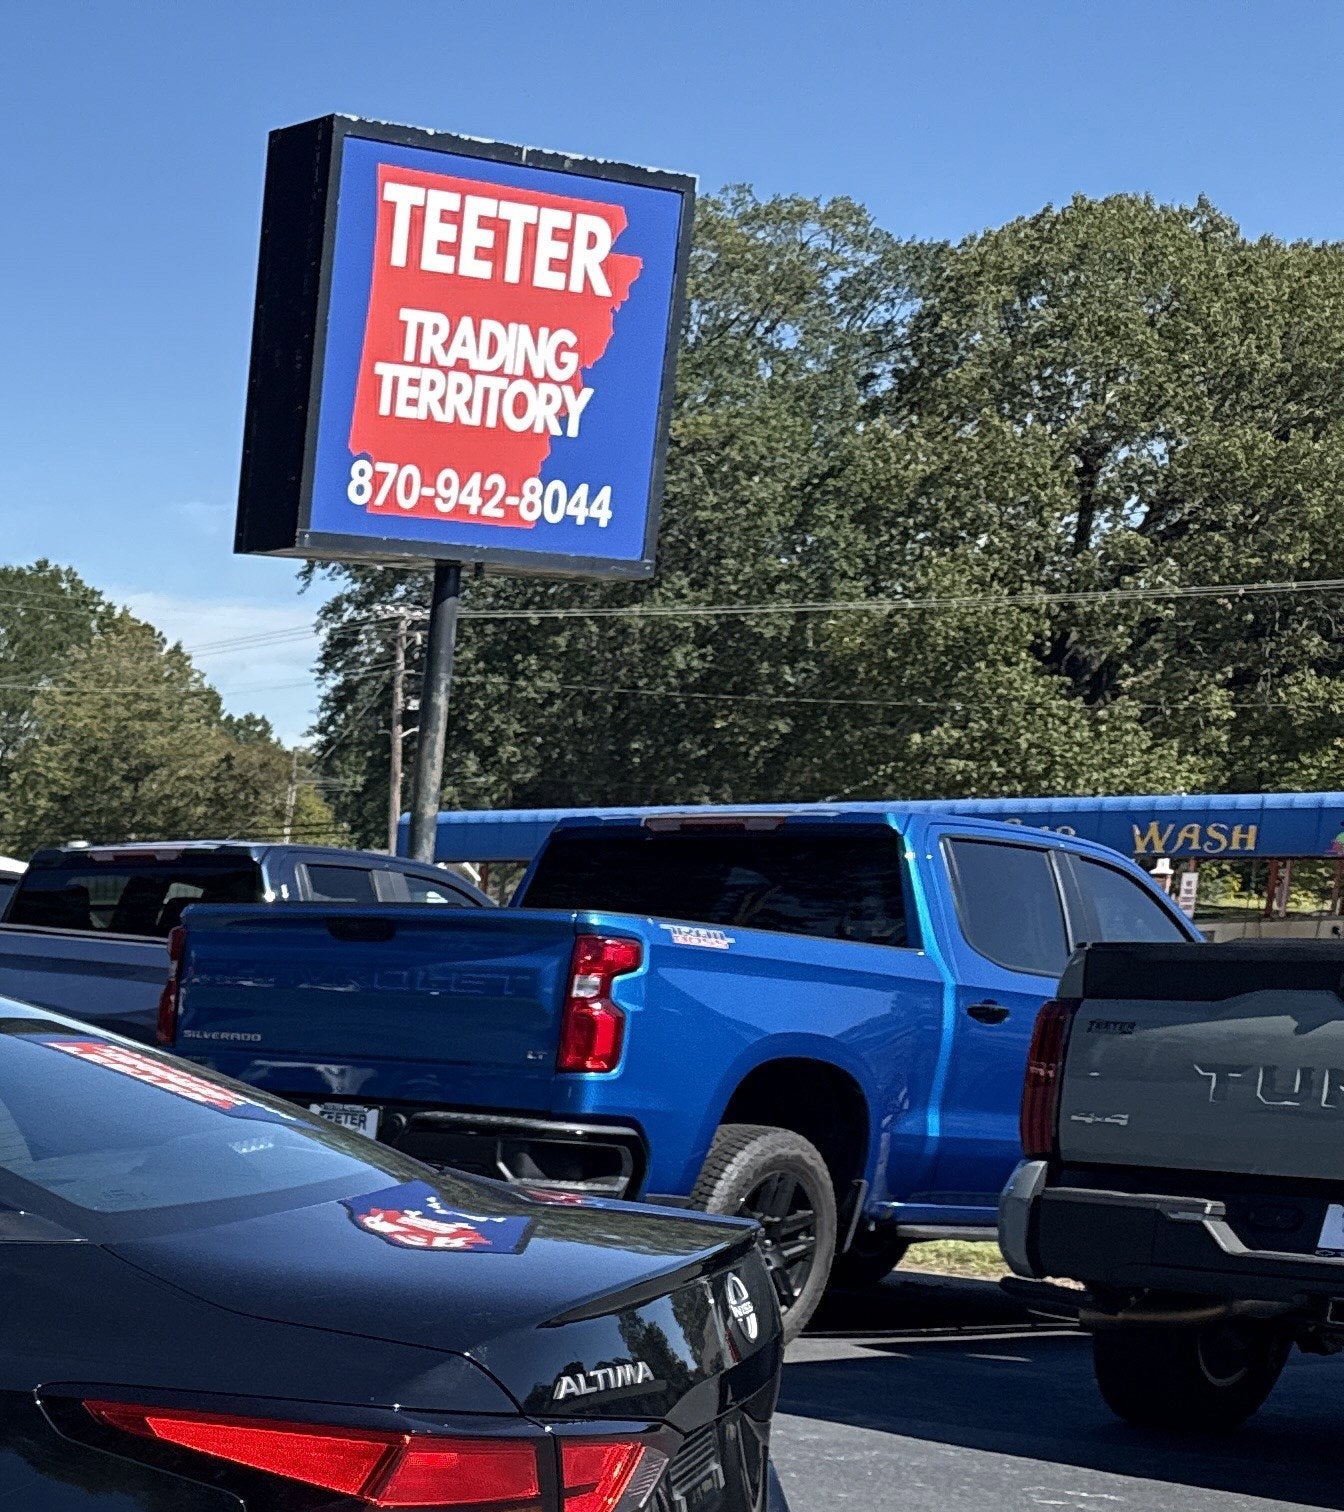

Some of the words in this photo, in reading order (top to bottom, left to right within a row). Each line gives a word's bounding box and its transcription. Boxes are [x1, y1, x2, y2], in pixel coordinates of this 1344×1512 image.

[383, 182, 613, 297] TEETER
[399, 308, 579, 382] TRADING
[374, 363, 594, 438] TERRITORY
[347, 460, 612, 528] 870-942-8044
[1132, 820, 1258, 854] WASH
[183, 1028, 262, 1042] SILVERADO
[526, 1049, 548, 1061] LT
[553, 1361, 655, 1400] ALTIMA
